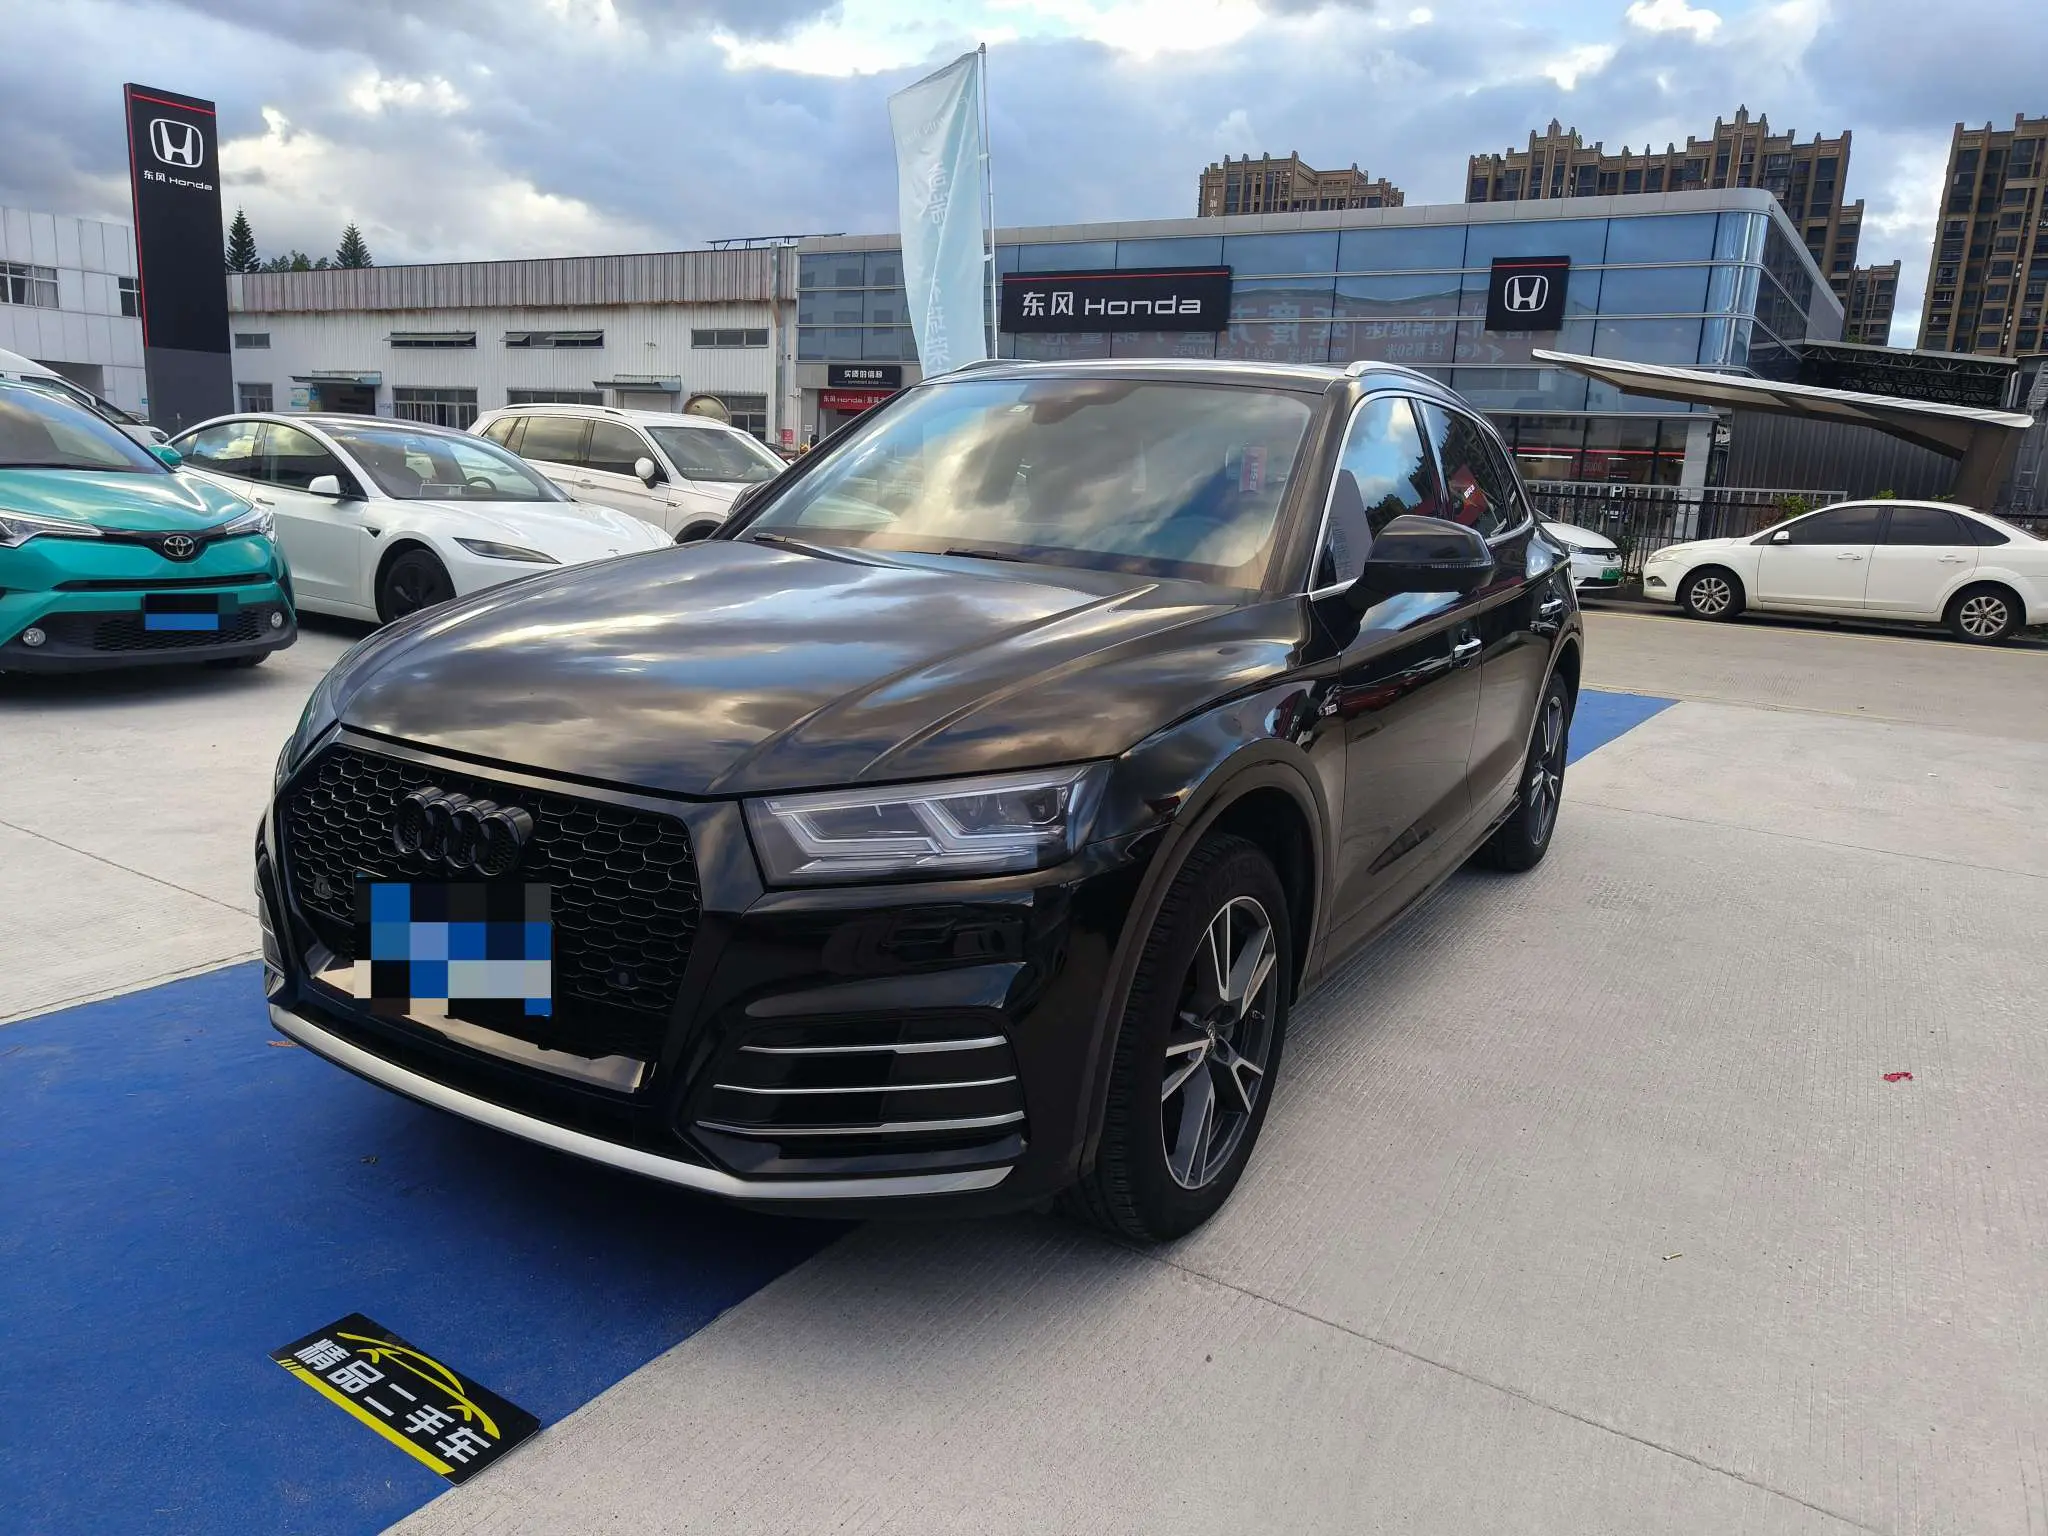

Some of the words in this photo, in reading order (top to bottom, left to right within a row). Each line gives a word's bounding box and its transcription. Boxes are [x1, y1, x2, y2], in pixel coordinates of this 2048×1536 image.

[144, 170, 166, 183] 东风
[169, 176, 213, 191] Honda
[1022, 291, 1074, 317] 东风
[1084, 294, 1202, 316] Honda
[293, 1338, 492, 1464] 精品二手车
